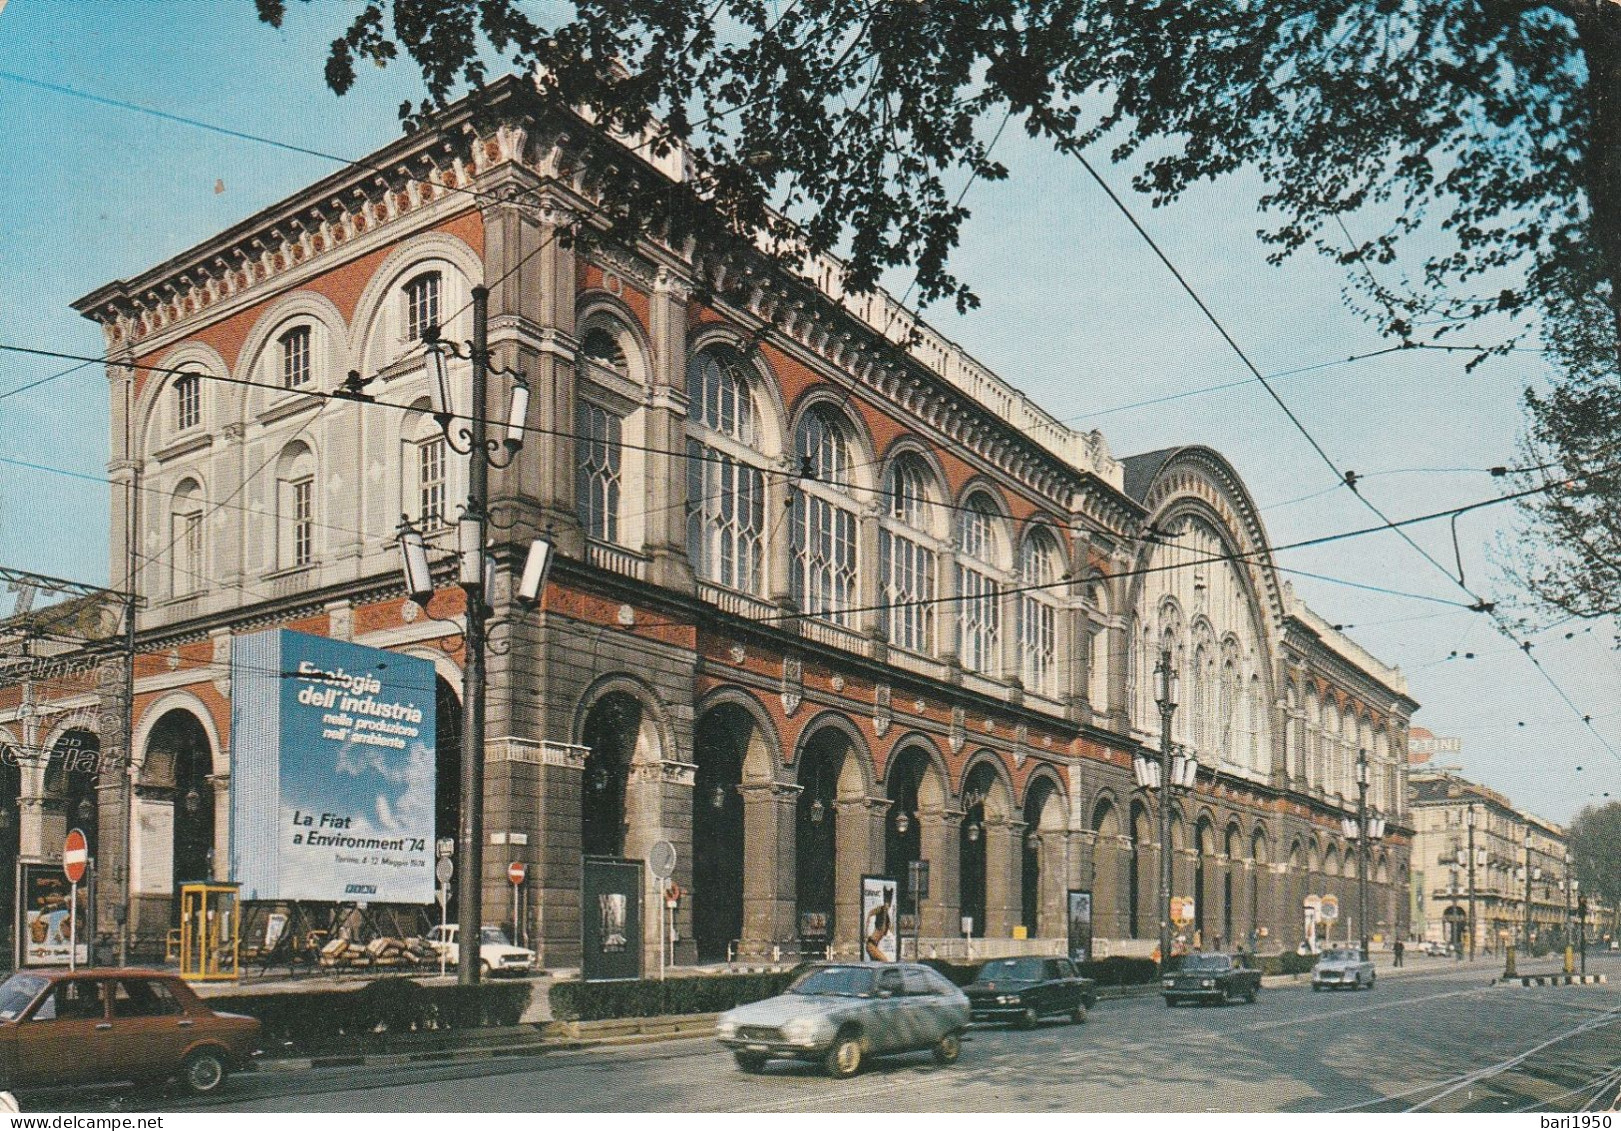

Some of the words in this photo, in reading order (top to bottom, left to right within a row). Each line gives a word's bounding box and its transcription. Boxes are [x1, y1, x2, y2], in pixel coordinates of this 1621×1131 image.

[298, 661, 381, 695] Ecologia
[293, 810, 313, 827] La
[320, 812, 352, 830] Fiat
[292, 833, 303, 845] a
